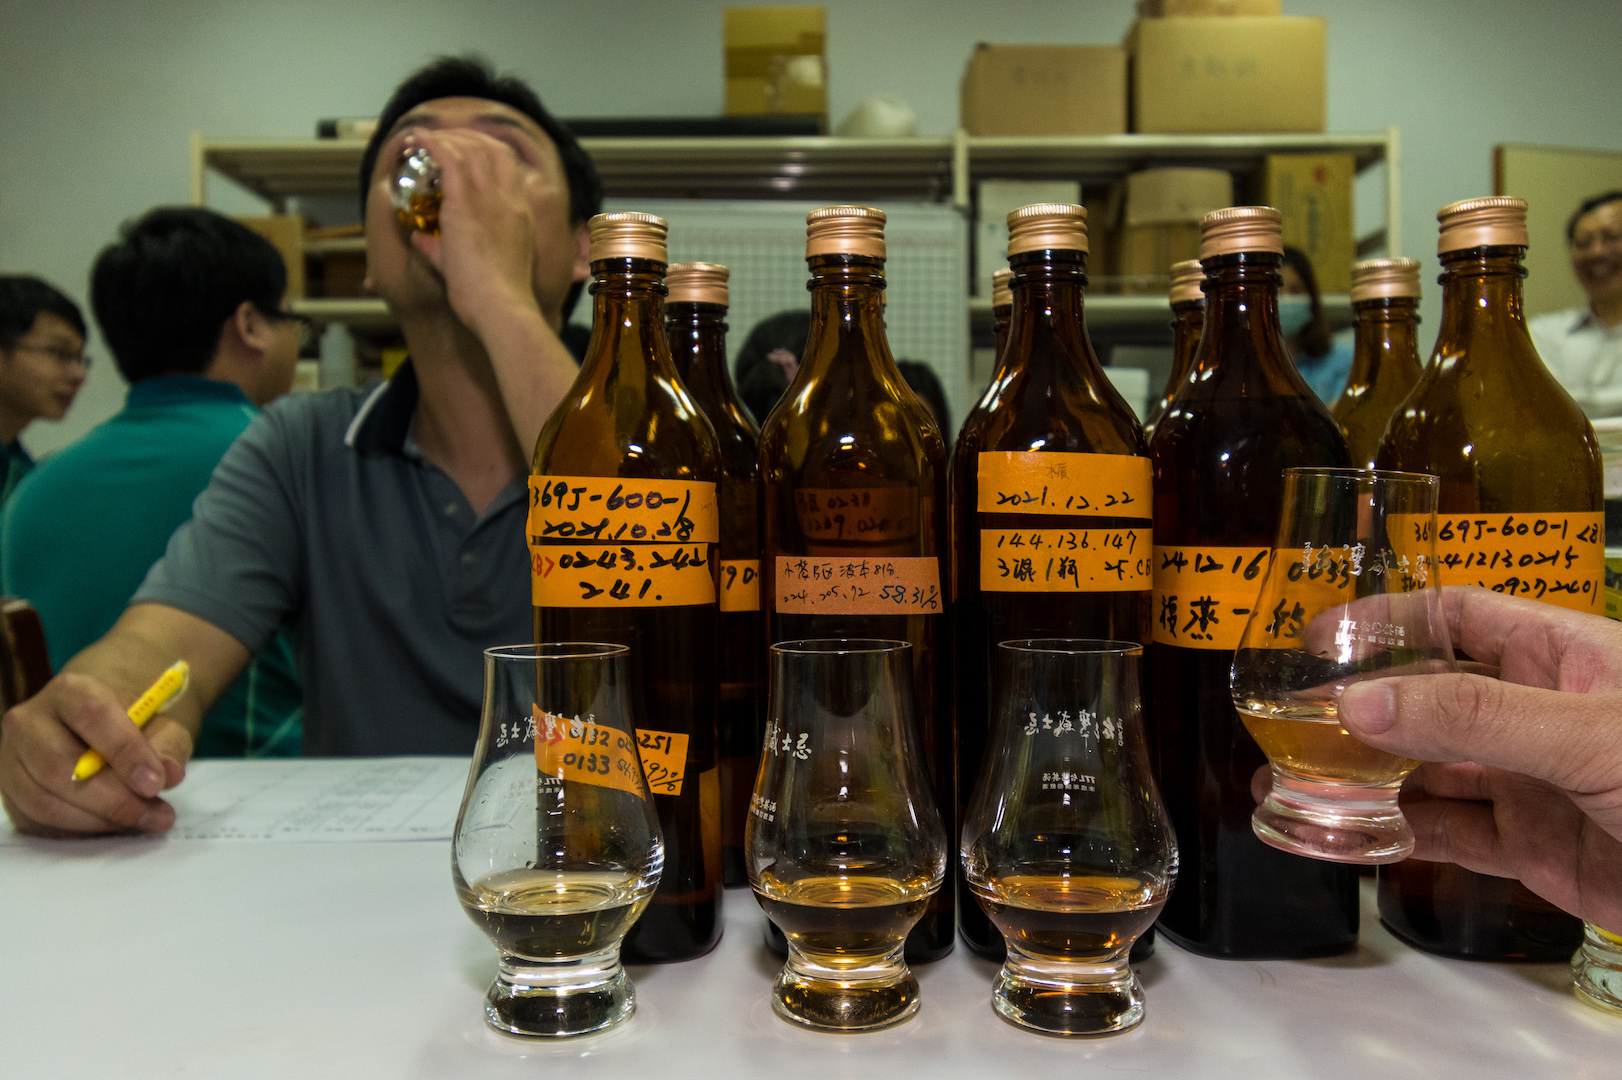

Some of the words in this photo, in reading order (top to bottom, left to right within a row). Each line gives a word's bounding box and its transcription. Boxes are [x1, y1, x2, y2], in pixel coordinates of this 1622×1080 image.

[996, 486, 1135, 511] 2021.12.22
[996, 530, 1138, 555] 144.136.147
[764, 717, 812, 761] 威士忌
